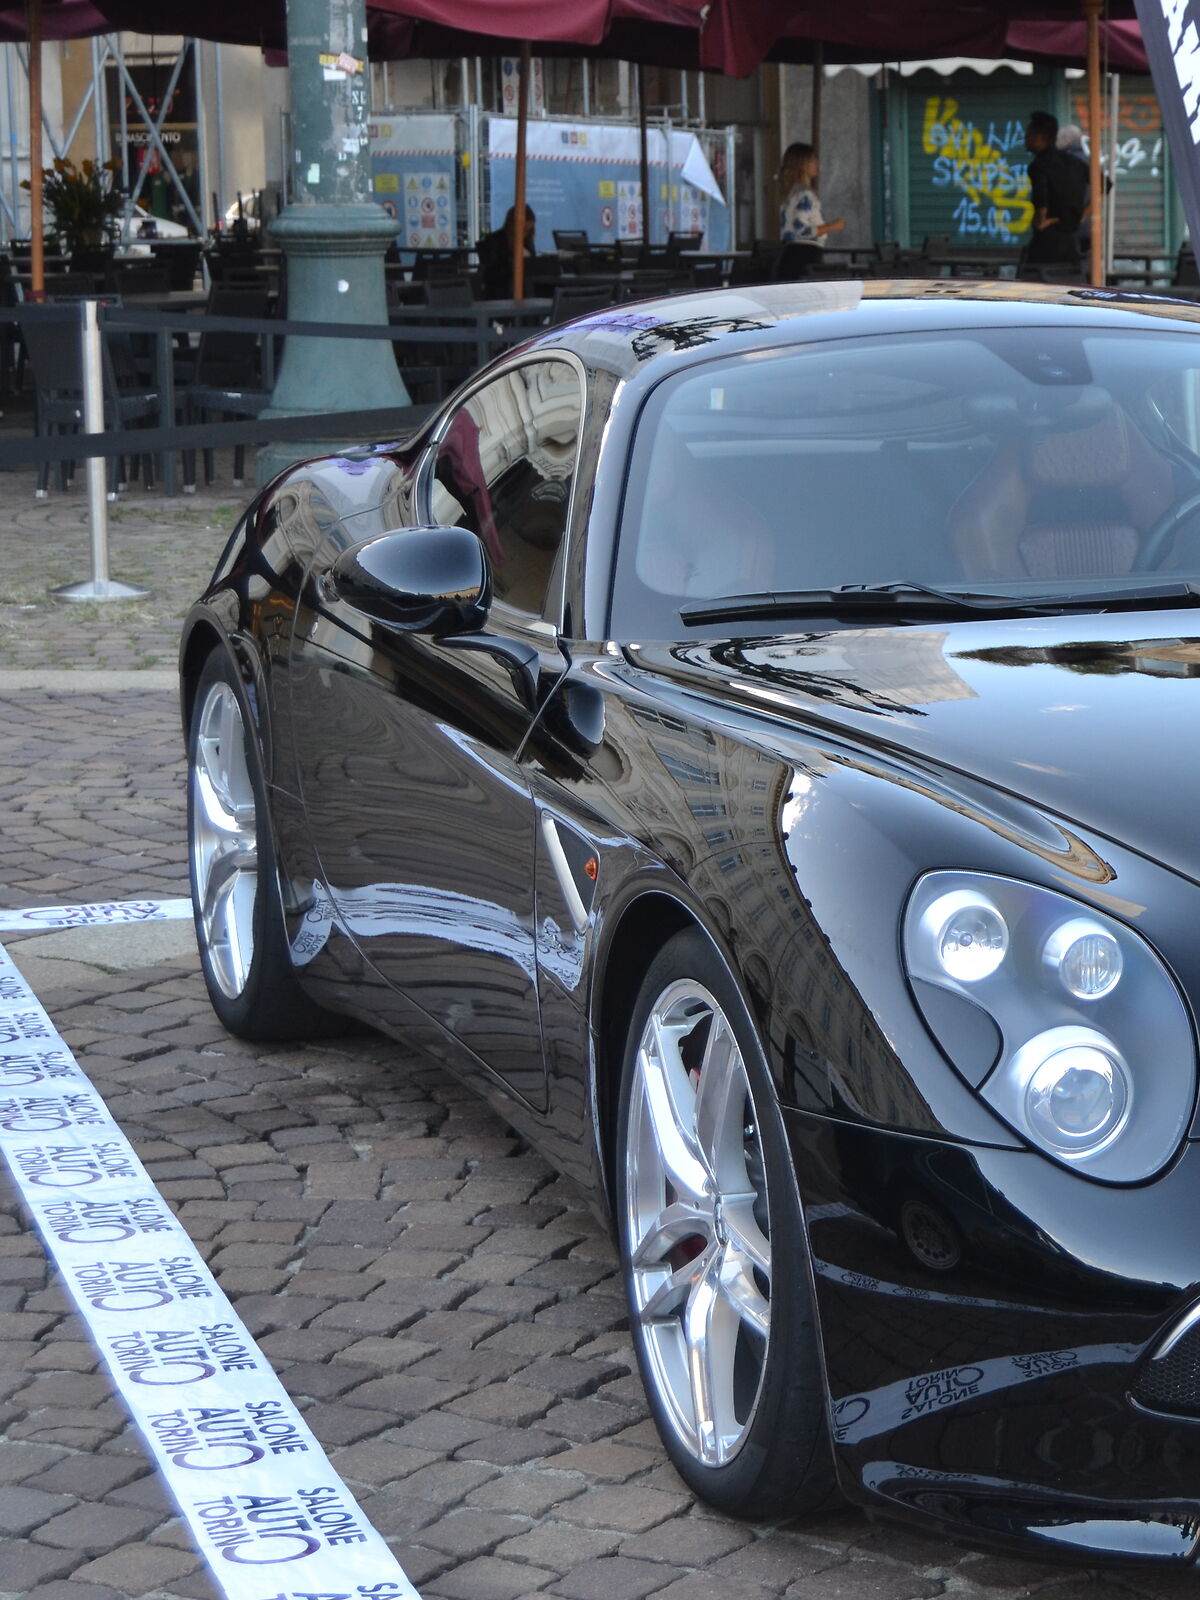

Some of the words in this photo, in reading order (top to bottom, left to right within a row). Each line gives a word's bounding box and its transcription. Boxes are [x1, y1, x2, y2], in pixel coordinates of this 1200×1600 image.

[2, 1096, 73, 1132] AUTO
[63, 1093, 105, 1126] SALONE
[28, 1145, 103, 1188] AUTO
[91, 1141, 138, 1179] SALONE
[57, 1200, 137, 1244] AUTO
[123, 1197, 173, 1234] SALONE
[91, 1260, 174, 1312] AUTO
[159, 1255, 213, 1300] SALONE
[128, 1330, 217, 1386] AUTO
[199, 1322, 258, 1373] SALONE
[172, 1407, 266, 1471] AUTO
[244, 1400, 309, 1455] SALONE
[221, 1495, 321, 1565] AUTO
[296, 1486, 368, 1547] SALONE
